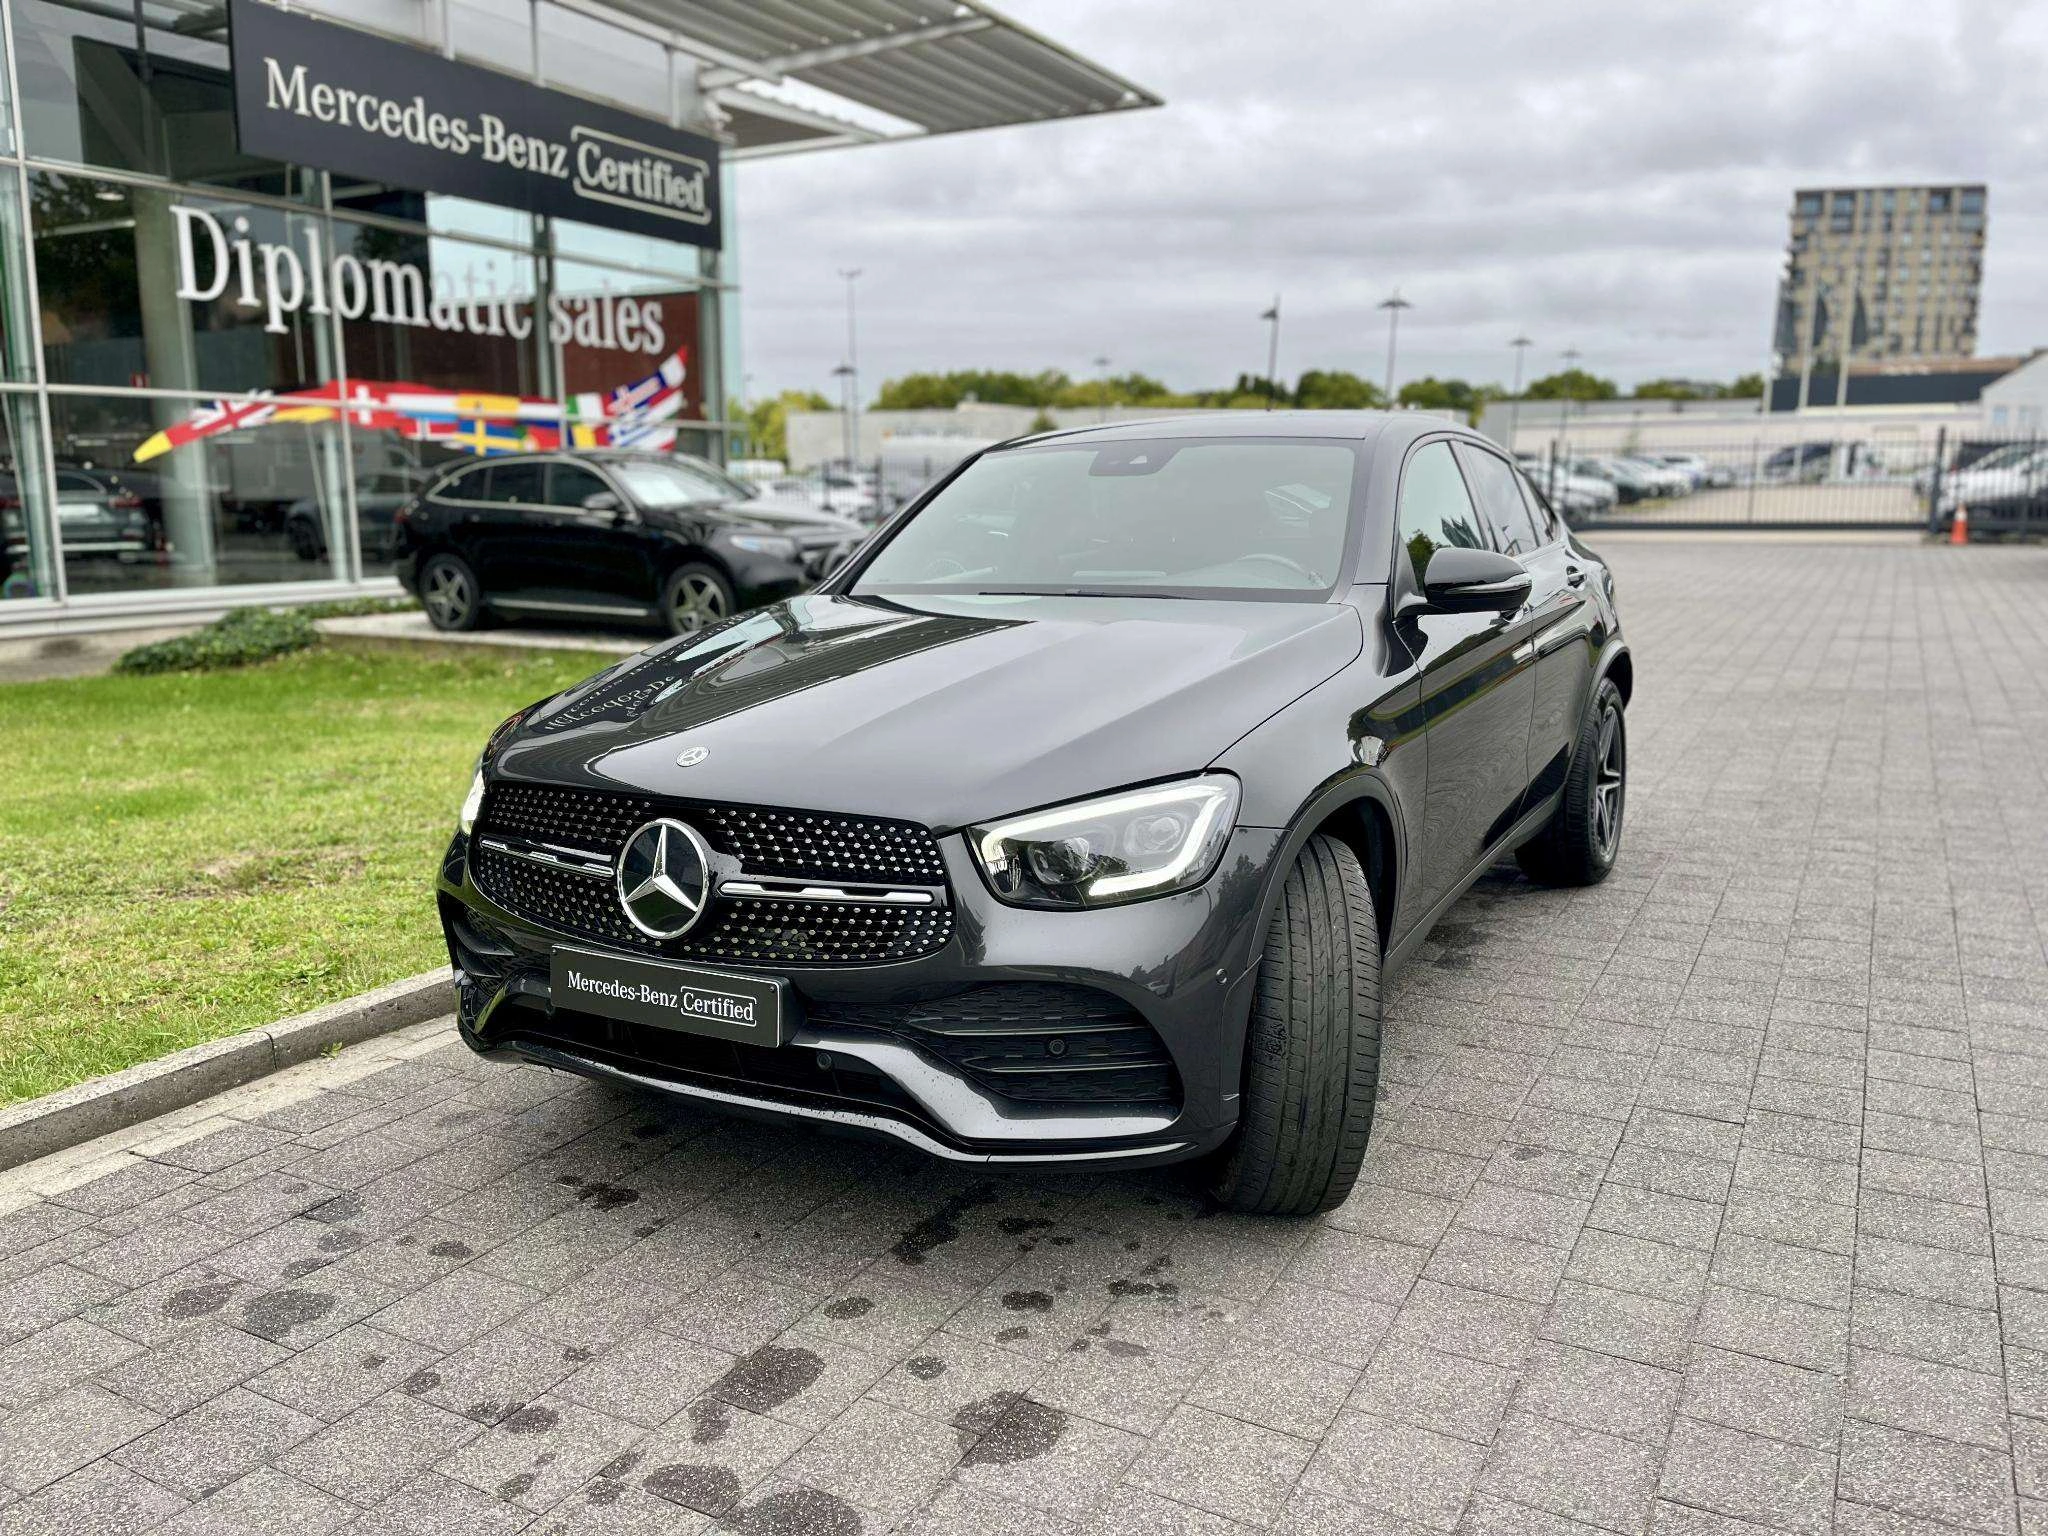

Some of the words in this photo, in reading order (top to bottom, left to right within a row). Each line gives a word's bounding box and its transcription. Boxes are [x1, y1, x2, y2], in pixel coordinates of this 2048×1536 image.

[264, 57, 569, 180] Mercedes-Benz
[577, 141, 706, 210] Certified
[169, 204, 533, 341] Diplomatic
[549, 276, 667, 355] sales
[567, 970, 678, 1009] Mercedes-Benz
[683, 991, 755, 1022] Certified
